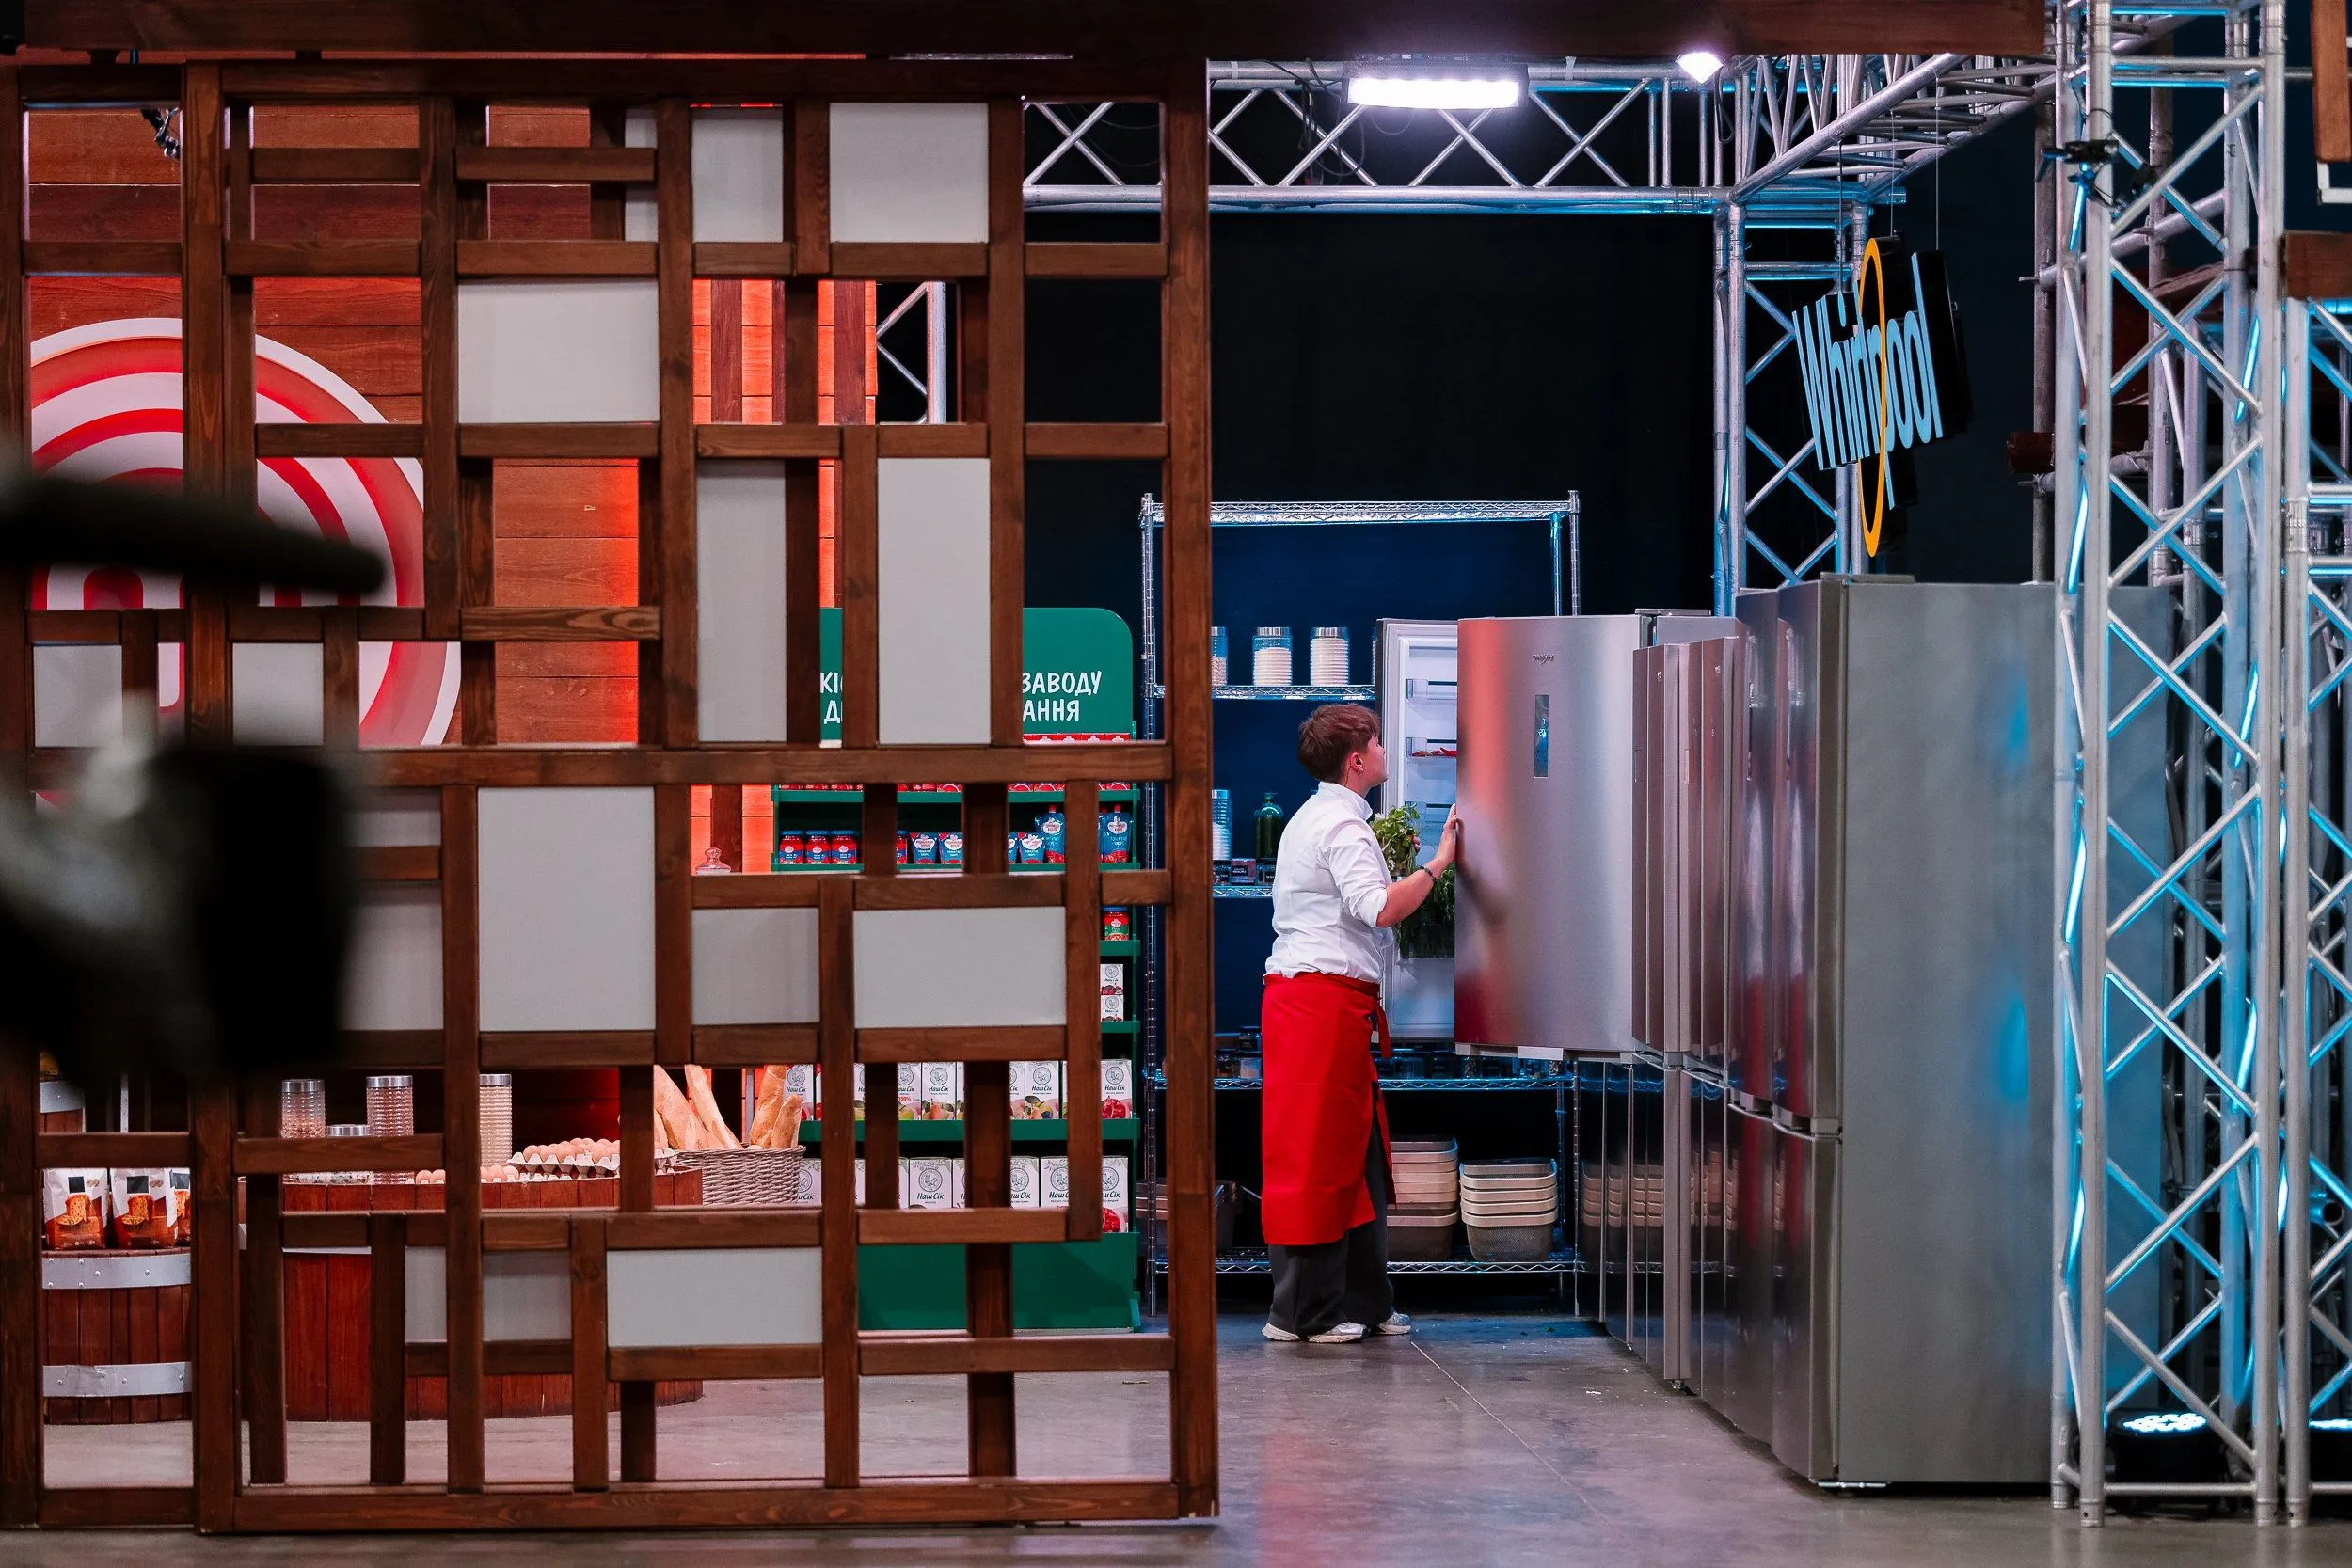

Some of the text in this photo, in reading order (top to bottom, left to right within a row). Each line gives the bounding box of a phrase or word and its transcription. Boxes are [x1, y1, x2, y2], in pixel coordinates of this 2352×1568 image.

[1792, 251, 1944, 510] Whirlpool
[1023, 671, 1102, 696] ЗАВОДУ
[1023, 698, 1080, 721] АННЯ
[917, 1192, 945, 1200] Наш Сік
[1020, 1191, 1031, 1199] Сік
[1109, 1190, 1120, 1198] Сік
